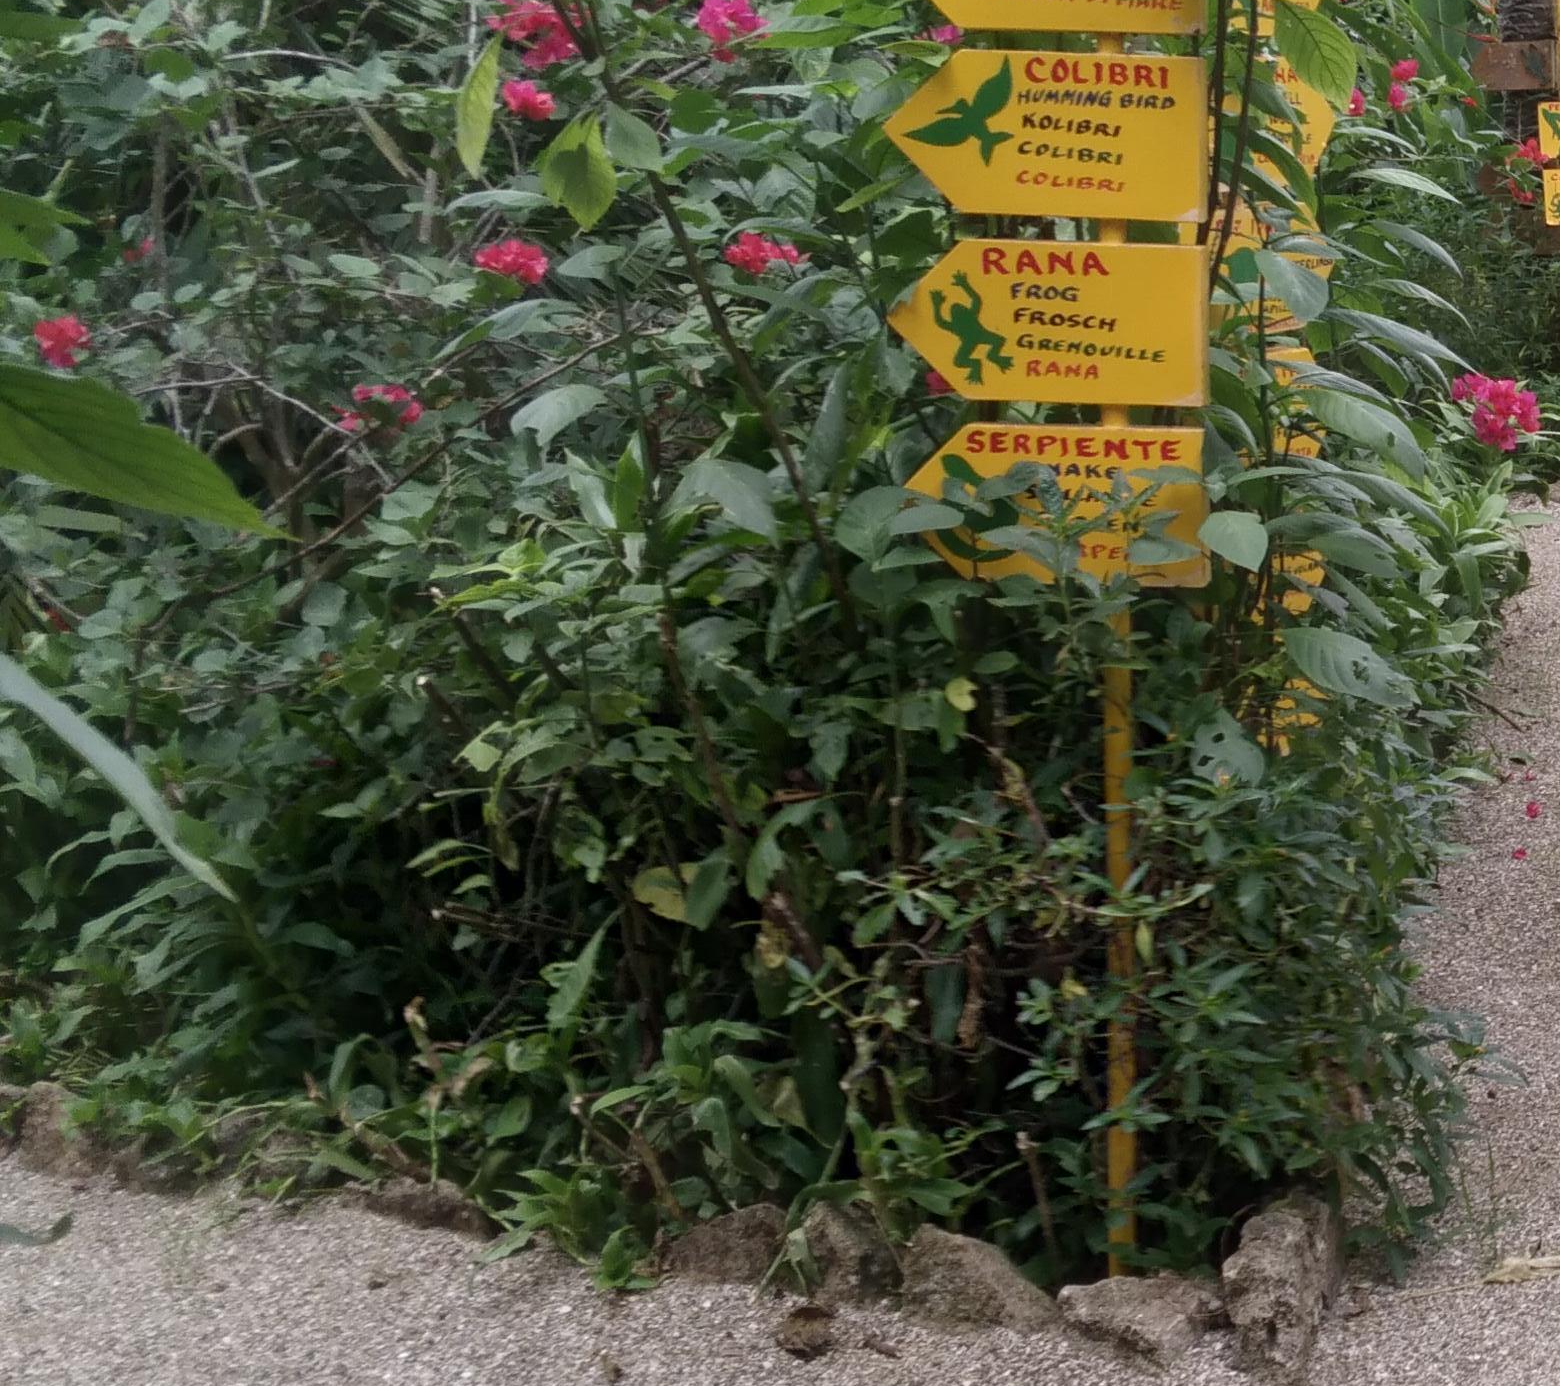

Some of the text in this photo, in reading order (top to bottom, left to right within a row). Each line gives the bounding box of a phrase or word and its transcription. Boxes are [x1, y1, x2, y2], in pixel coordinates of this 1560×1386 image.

[1025, 57, 1170, 89] COLIBRI
[1017, 88, 1176, 110] HUMMING BIRD
[1022, 113, 1122, 137] KOLIBRI
[1017, 141, 1124, 165] COLIBRI
[1016, 170, 1126, 193] COLIBRI
[982, 247, 1110, 276] RANA
[1011, 281, 1080, 302] FROG
[1013, 307, 1117, 332] FROSCH
[1016, 333, 1166, 362] GRENOUILLE
[1026, 359, 1099, 380] RANA
[966, 430, 1182, 461] SERPIENTE
[1048, 462, 1118, 480] NAKE
